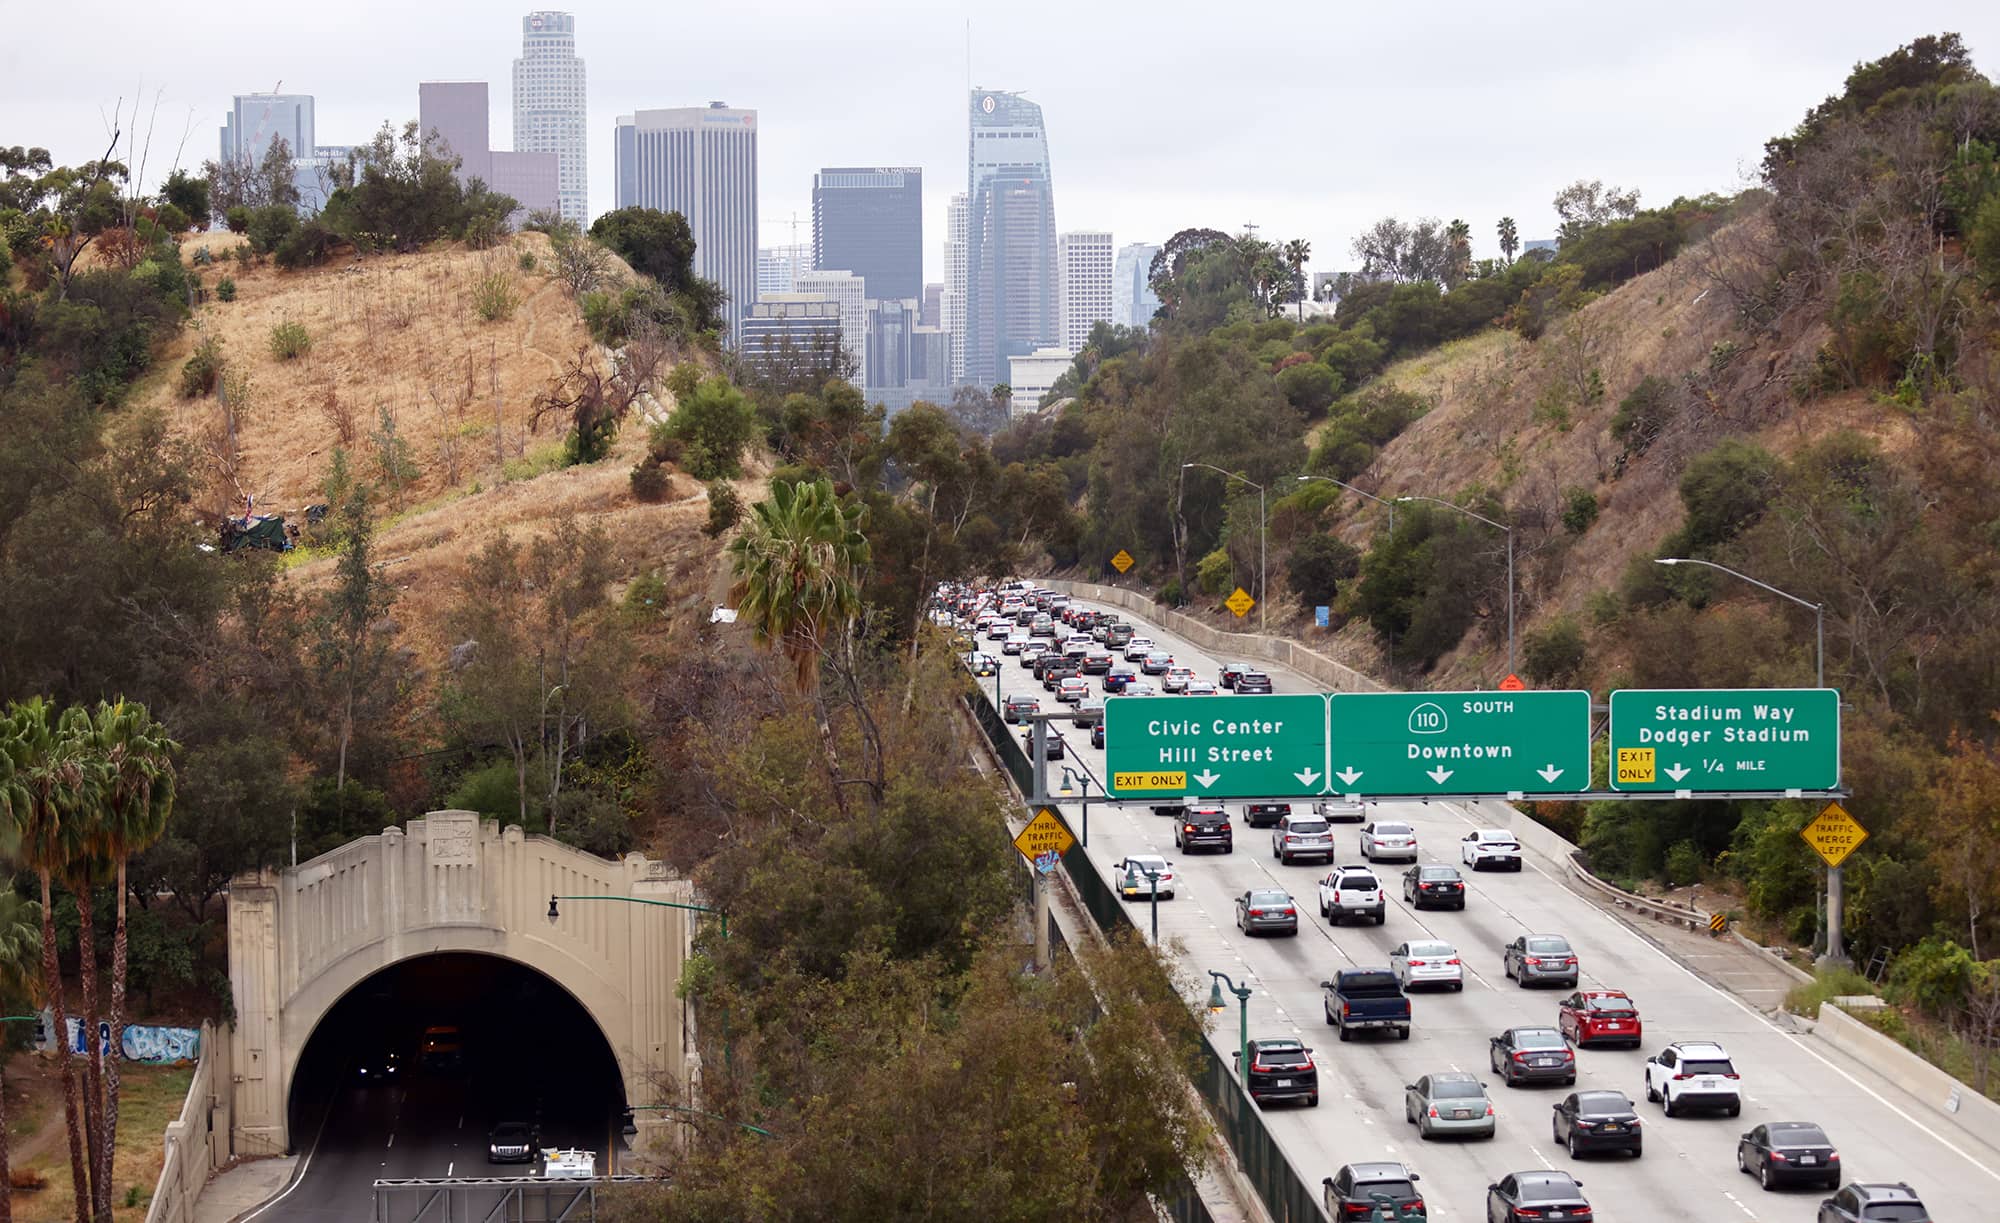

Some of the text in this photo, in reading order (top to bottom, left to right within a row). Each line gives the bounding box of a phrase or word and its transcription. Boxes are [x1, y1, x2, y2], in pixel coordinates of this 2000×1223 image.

[891, 167, 921, 175] HASTINGS
[1463, 701, 1514, 714] SOUTH
[1655, 704, 1794, 724] Stadium Way
[1417, 712, 1439, 728] 110
[1148, 719, 1283, 736] Civic Center
[1639, 726, 1809, 747] Dodger Stadium
[1159, 746, 1273, 763] Hill Street
[1407, 743, 1512, 759] Downtown
[1620, 751, 1652, 762] EXIT
[1736, 760, 1766, 771] MILE
[1619, 769, 1652, 779] ONLY
[1116, 775, 1184, 786] EXIT ONLY
[1822, 814, 1846, 822] THRU
[1033, 822, 1056, 830] THRU
[1815, 824, 1854, 833] TRAFFIC
[1027, 831, 1063, 841] TRAFFIC
[1816, 835, 1852, 844] MERGE
[1030, 842, 1059, 851] MERGE
[1822, 846, 1847, 855] LEFT
